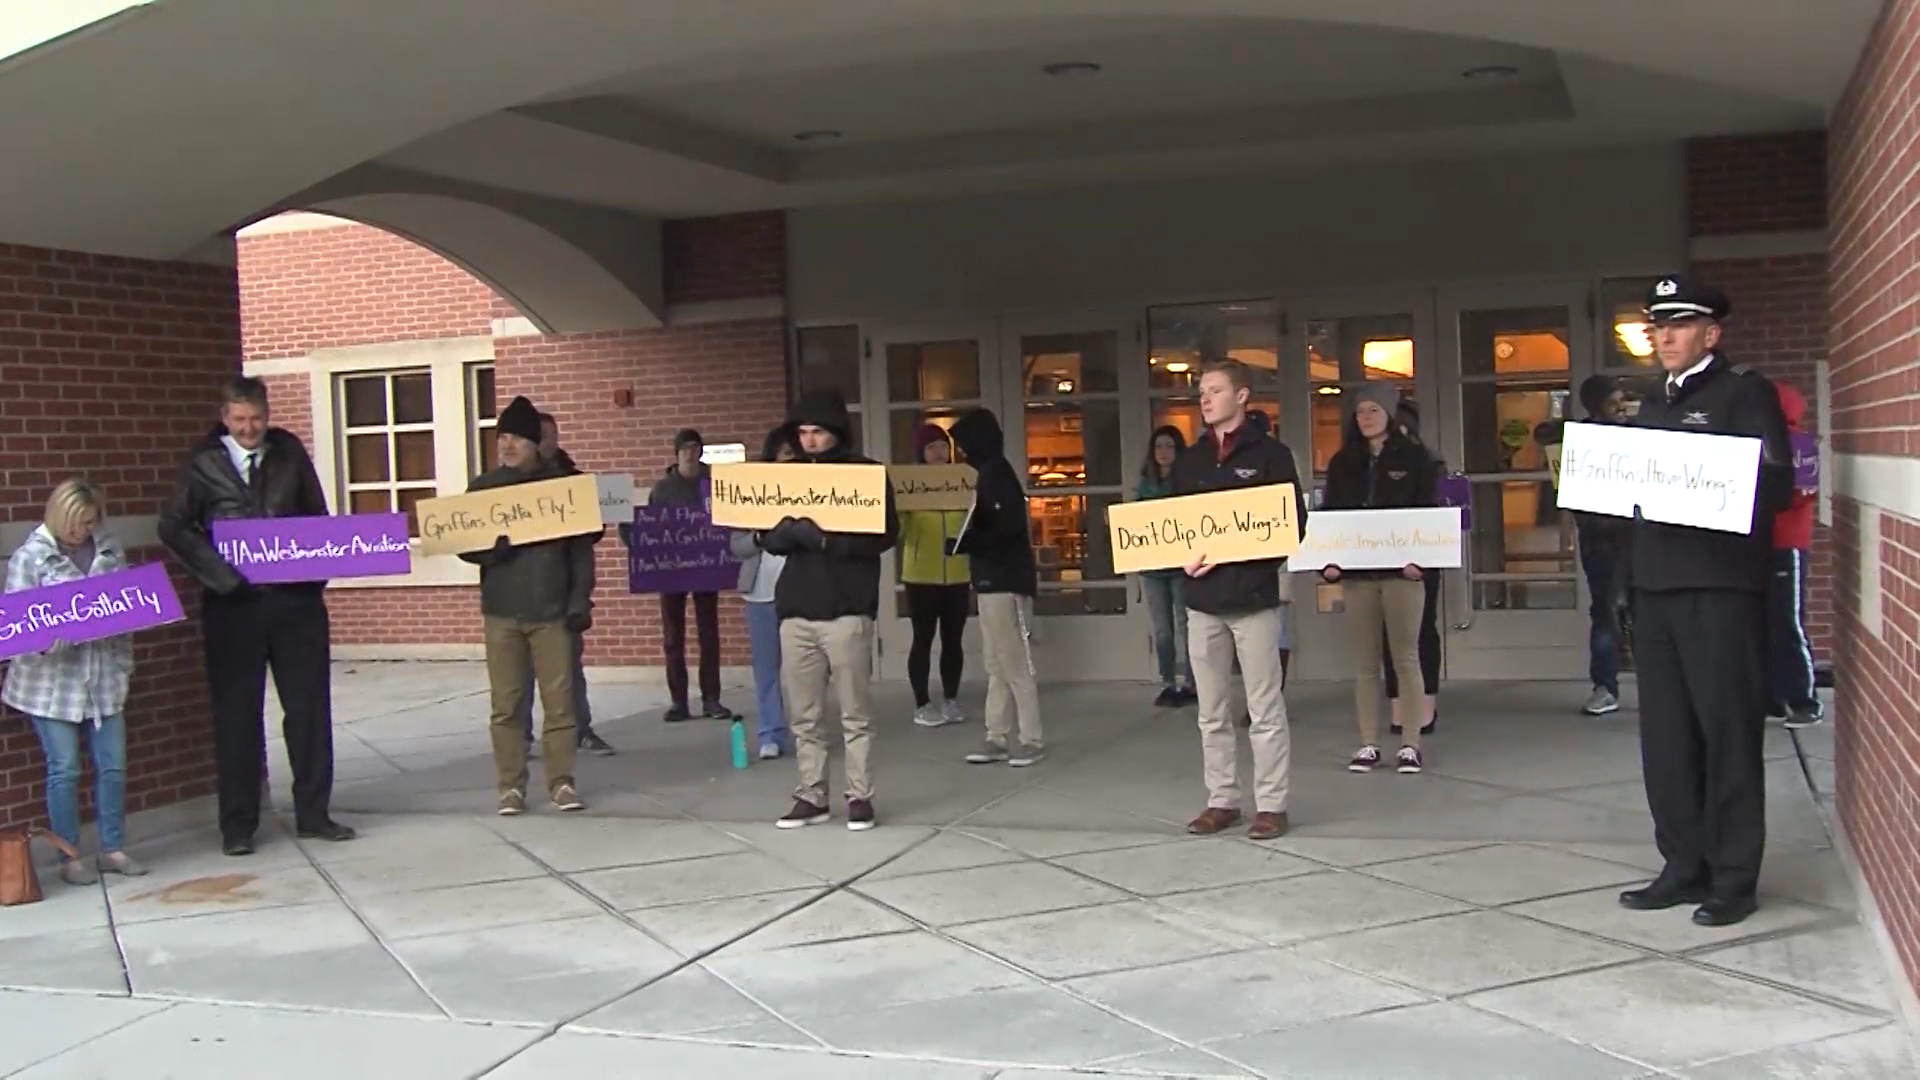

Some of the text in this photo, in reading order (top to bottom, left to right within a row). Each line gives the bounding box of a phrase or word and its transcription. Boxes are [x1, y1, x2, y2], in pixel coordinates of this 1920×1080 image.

[423, 489, 577, 540] Griffins Gotta Fly!
[1118, 495, 1289, 550] Don't Clip Our Wings!
